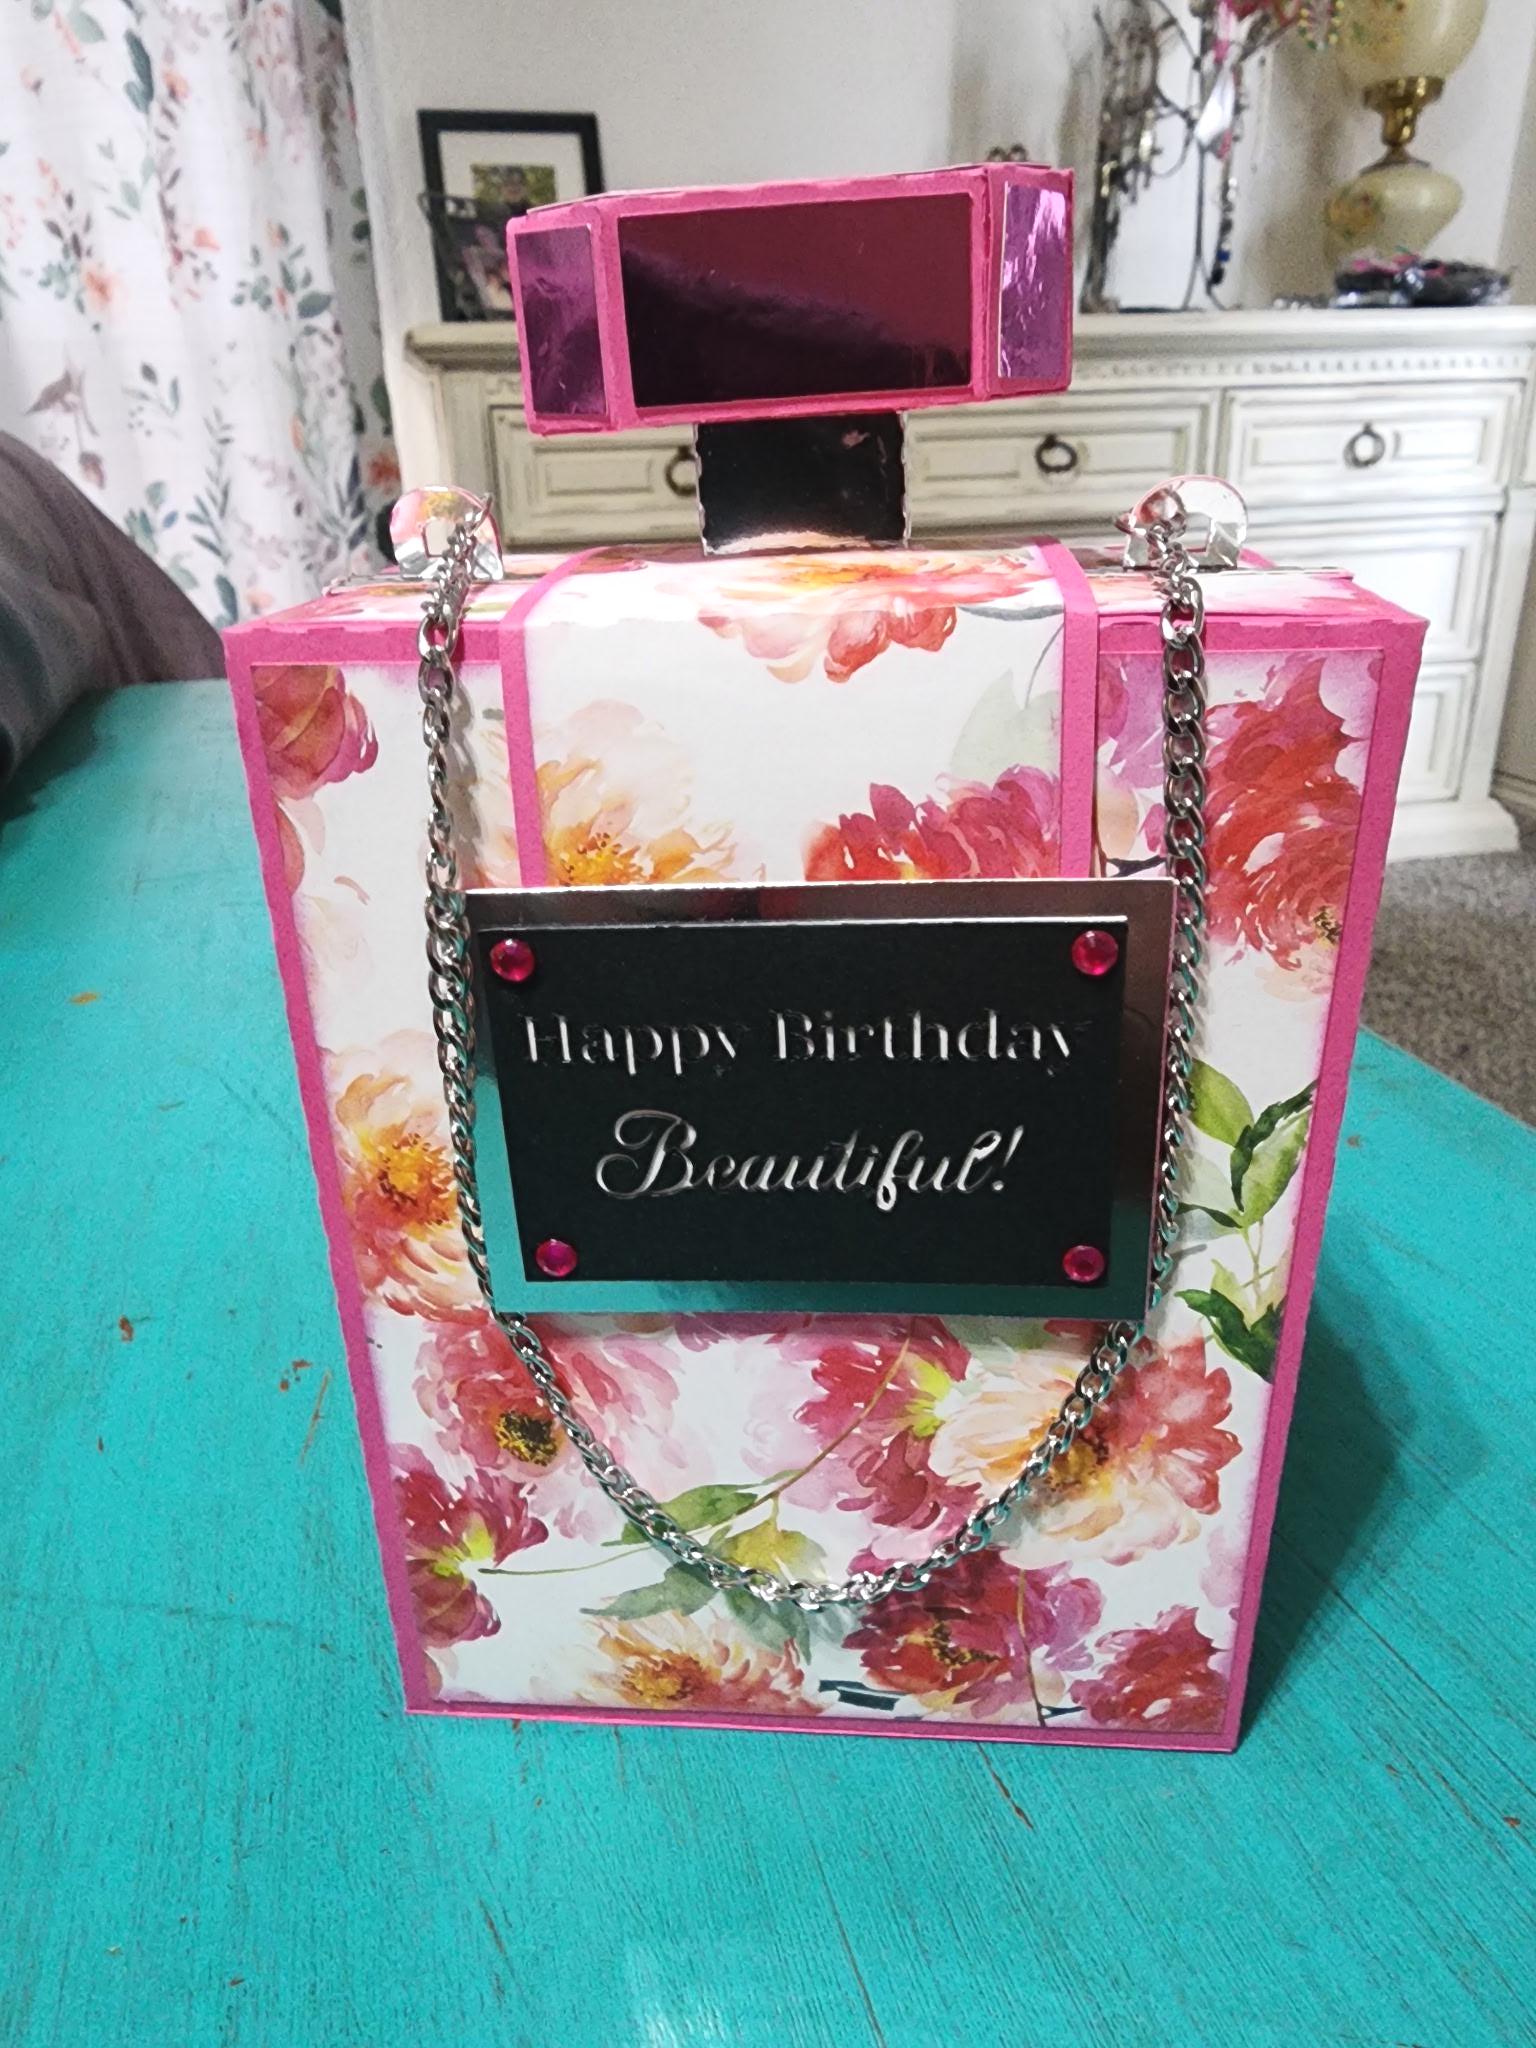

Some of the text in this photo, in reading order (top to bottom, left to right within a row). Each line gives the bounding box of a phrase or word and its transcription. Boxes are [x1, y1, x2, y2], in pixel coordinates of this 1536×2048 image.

[519, 1008, 1088, 1077] Happy Birthday
[596, 1108, 1025, 1212] Beautiful!
